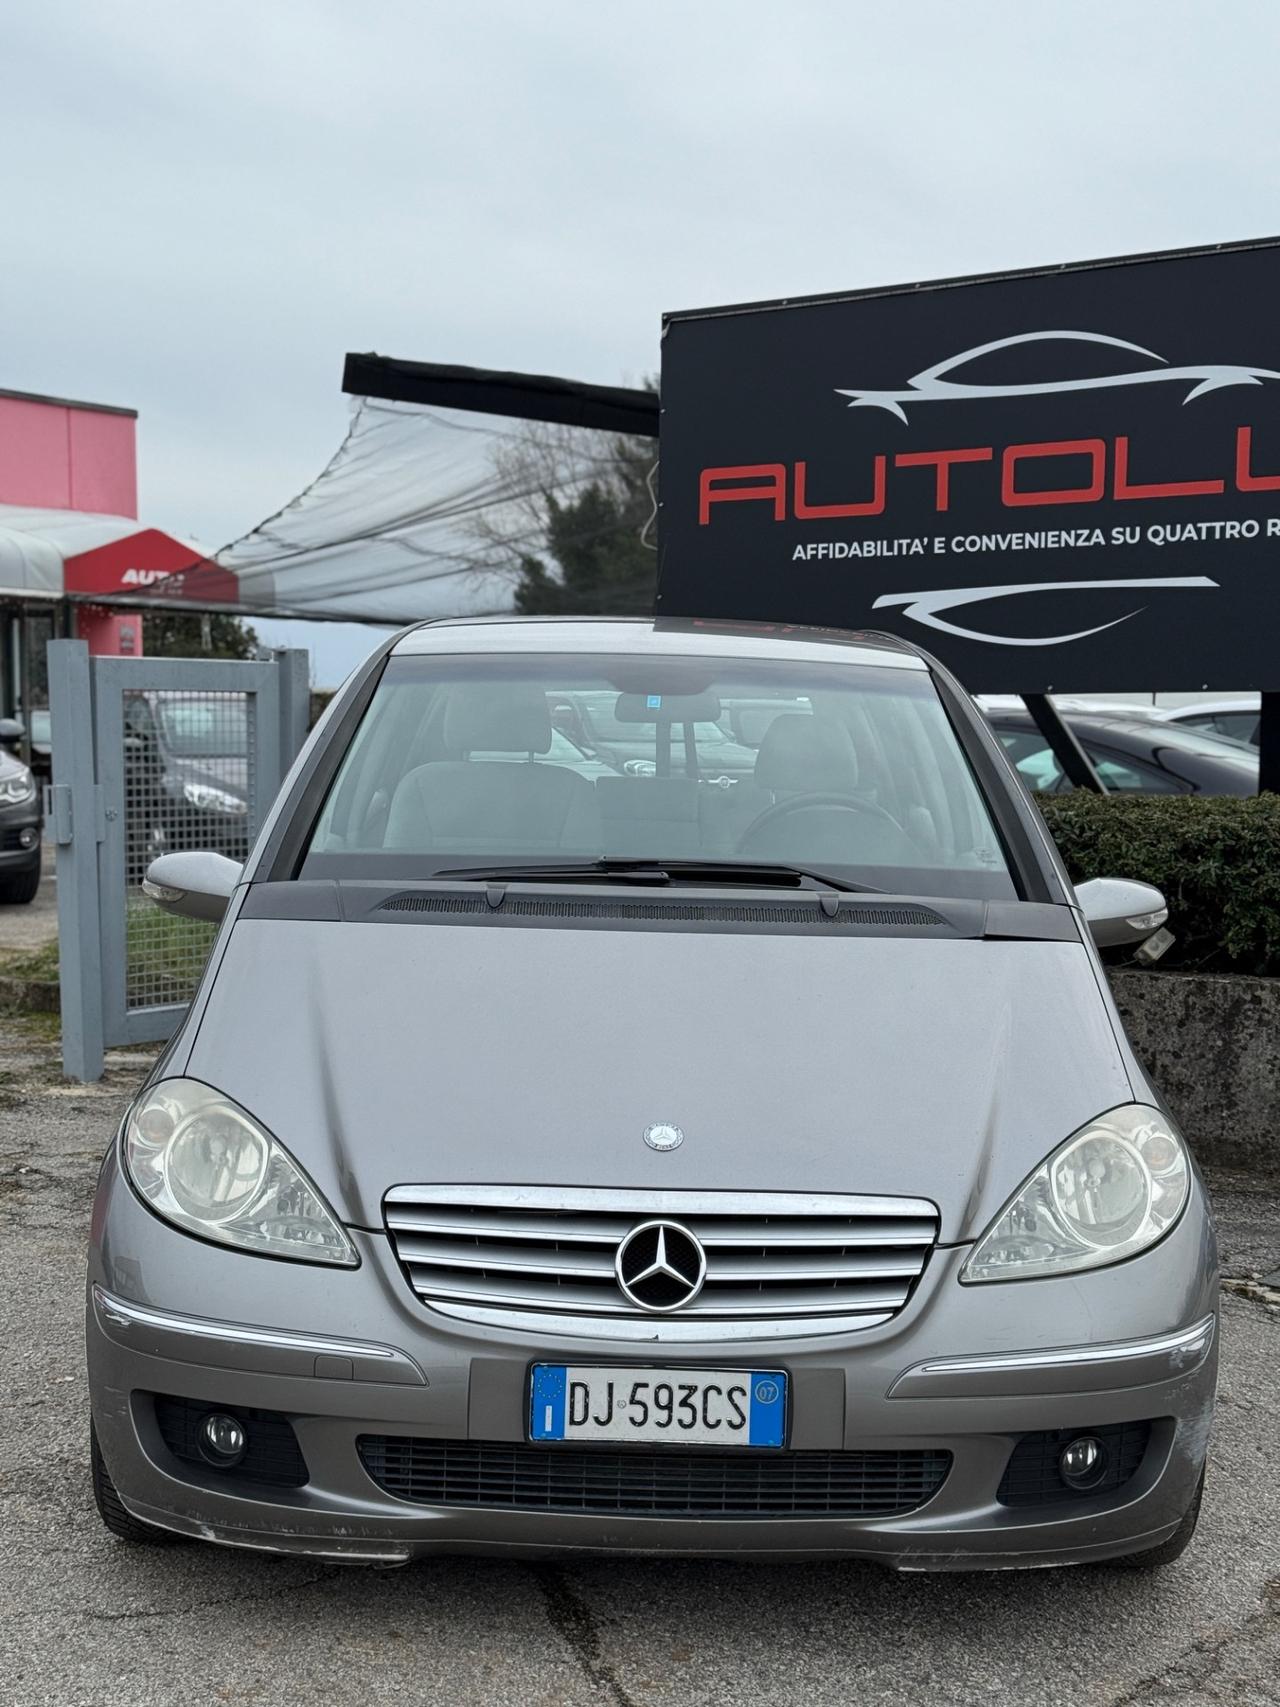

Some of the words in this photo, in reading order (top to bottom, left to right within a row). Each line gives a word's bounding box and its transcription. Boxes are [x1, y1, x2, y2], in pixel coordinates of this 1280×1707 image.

[933, 536, 946, 554] E
[950, 528, 1106, 553] CONVENIENZA
[1110, 526, 1141, 545] SU
[1146, 519, 1260, 546] QUATTRO
